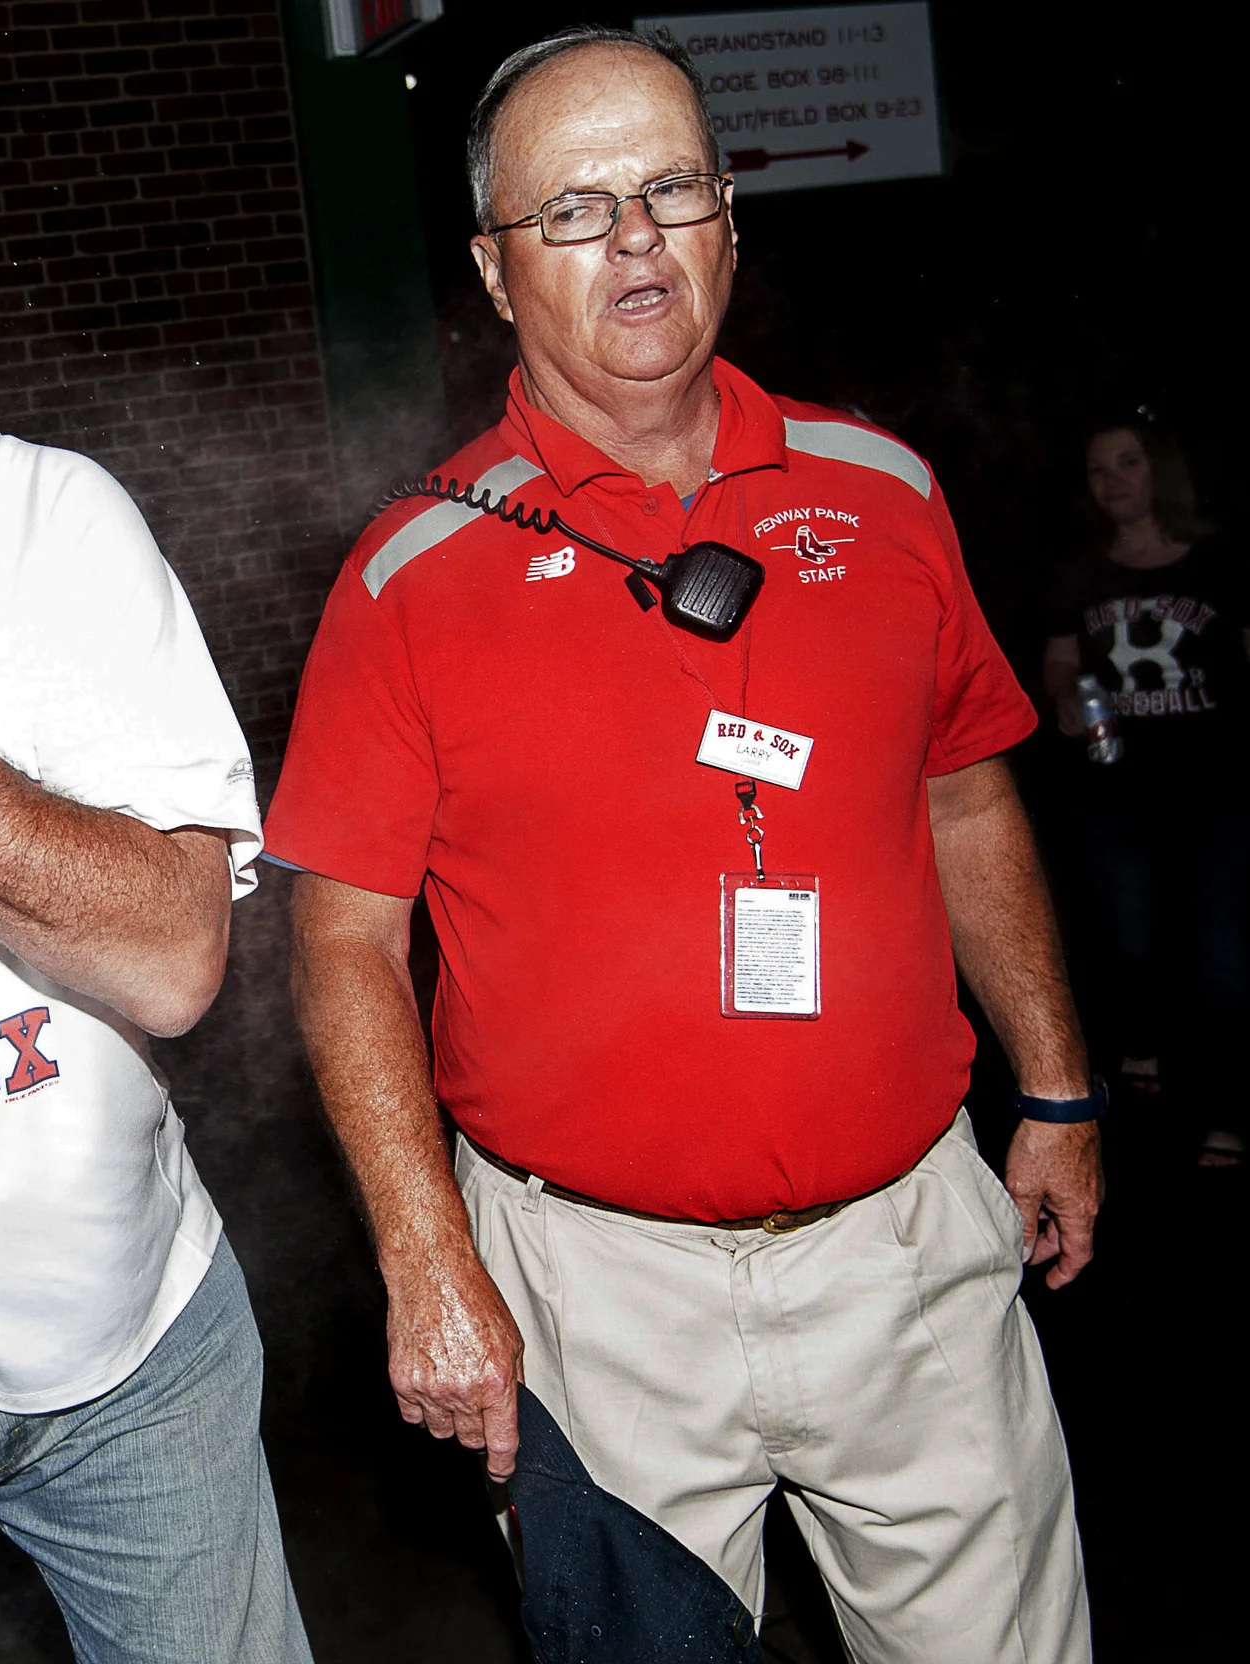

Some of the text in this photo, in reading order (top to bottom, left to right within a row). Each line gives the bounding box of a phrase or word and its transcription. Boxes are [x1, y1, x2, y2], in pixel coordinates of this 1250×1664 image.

[686, 22, 885, 56] GRANDSTAND 11-13
[704, 72, 759, 94] OGE
[767, 68, 811, 89] BOX
[712, 107, 818, 134] OUT/FIELD
[825, 102, 867, 124] BOX
[753, 507, 860, 538] FENWAY PARK
[798, 566, 847, 584] STAFF
[1151, 594, 1217, 635] SOX
[1111, 688, 1217, 717] SEBALL
[717, 723, 800, 760] RED SOX
[736, 743, 773, 761] LARRY
